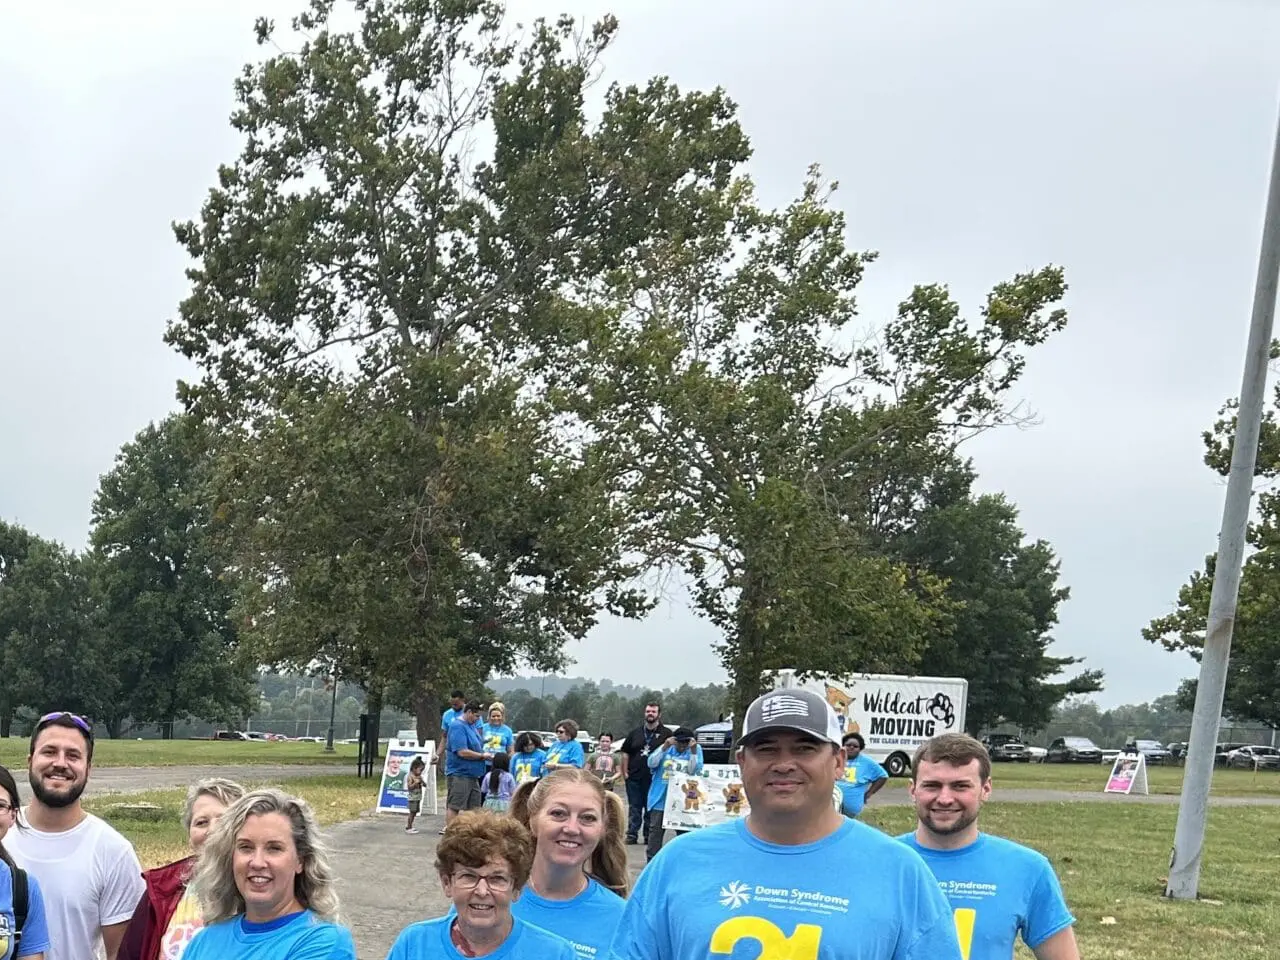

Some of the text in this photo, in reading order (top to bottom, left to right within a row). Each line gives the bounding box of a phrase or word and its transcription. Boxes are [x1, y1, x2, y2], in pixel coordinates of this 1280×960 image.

[864, 688, 928, 715] Wildcat
[870, 717, 935, 737] MOVING
[755, 885, 850, 907] Down Syndrome
[948, 880, 997, 892] Syndrome
